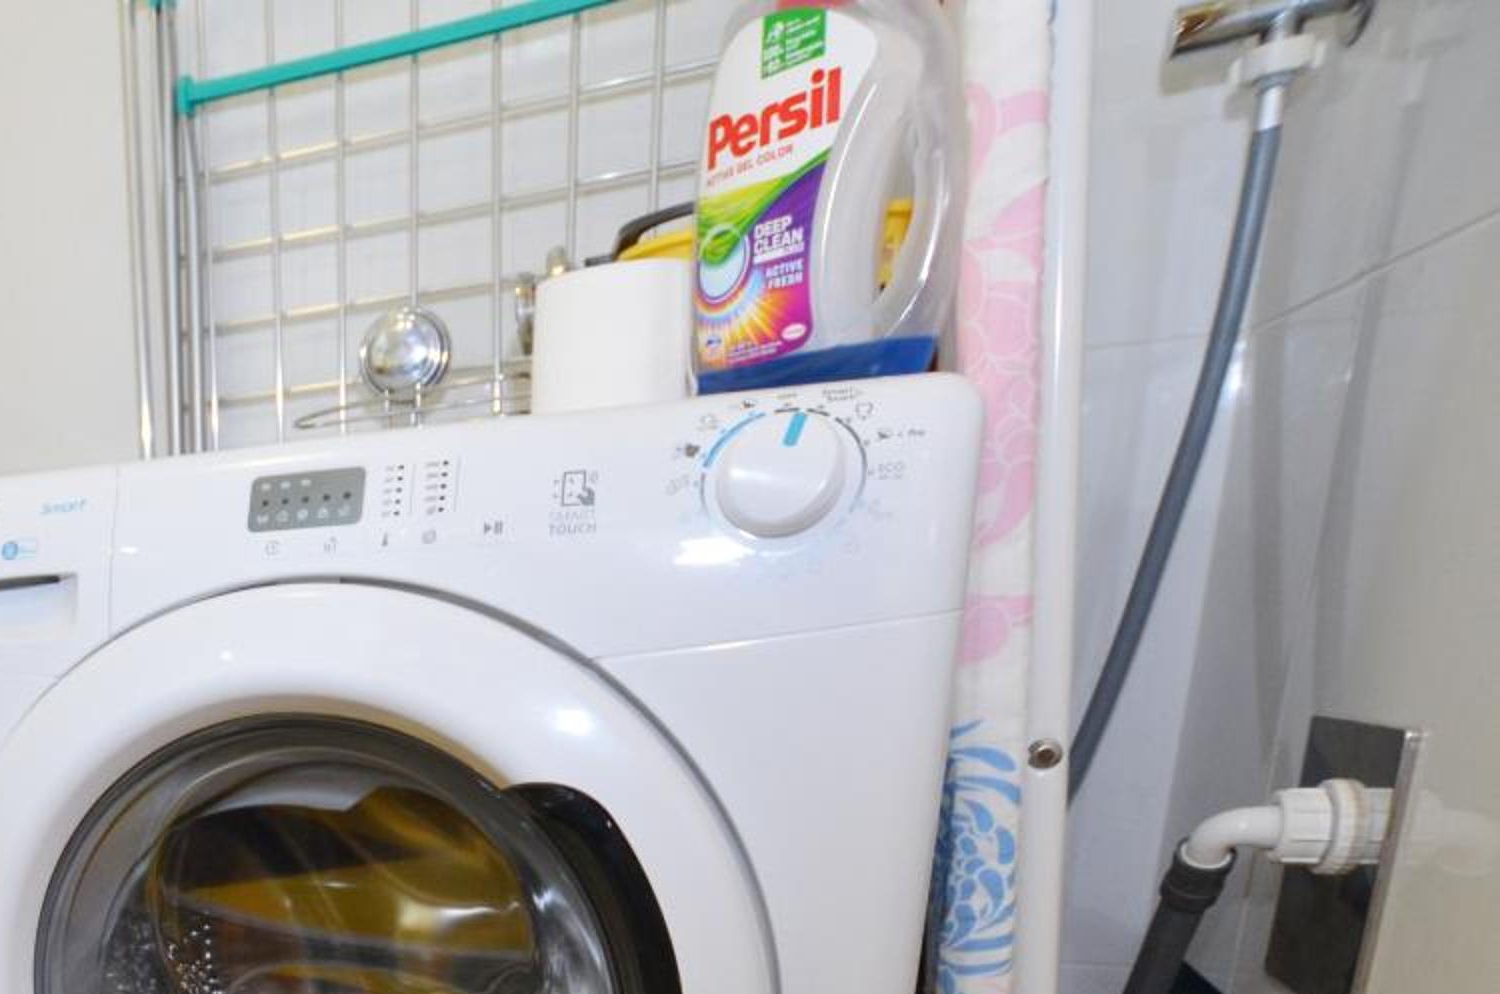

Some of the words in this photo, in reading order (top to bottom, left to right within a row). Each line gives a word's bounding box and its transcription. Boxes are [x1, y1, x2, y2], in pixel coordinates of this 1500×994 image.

[707, 66, 842, 171] Persil
[756, 144, 794, 166] COLOR
[754, 215, 792, 240] DEEP
[754, 227, 804, 255] CLEAN
